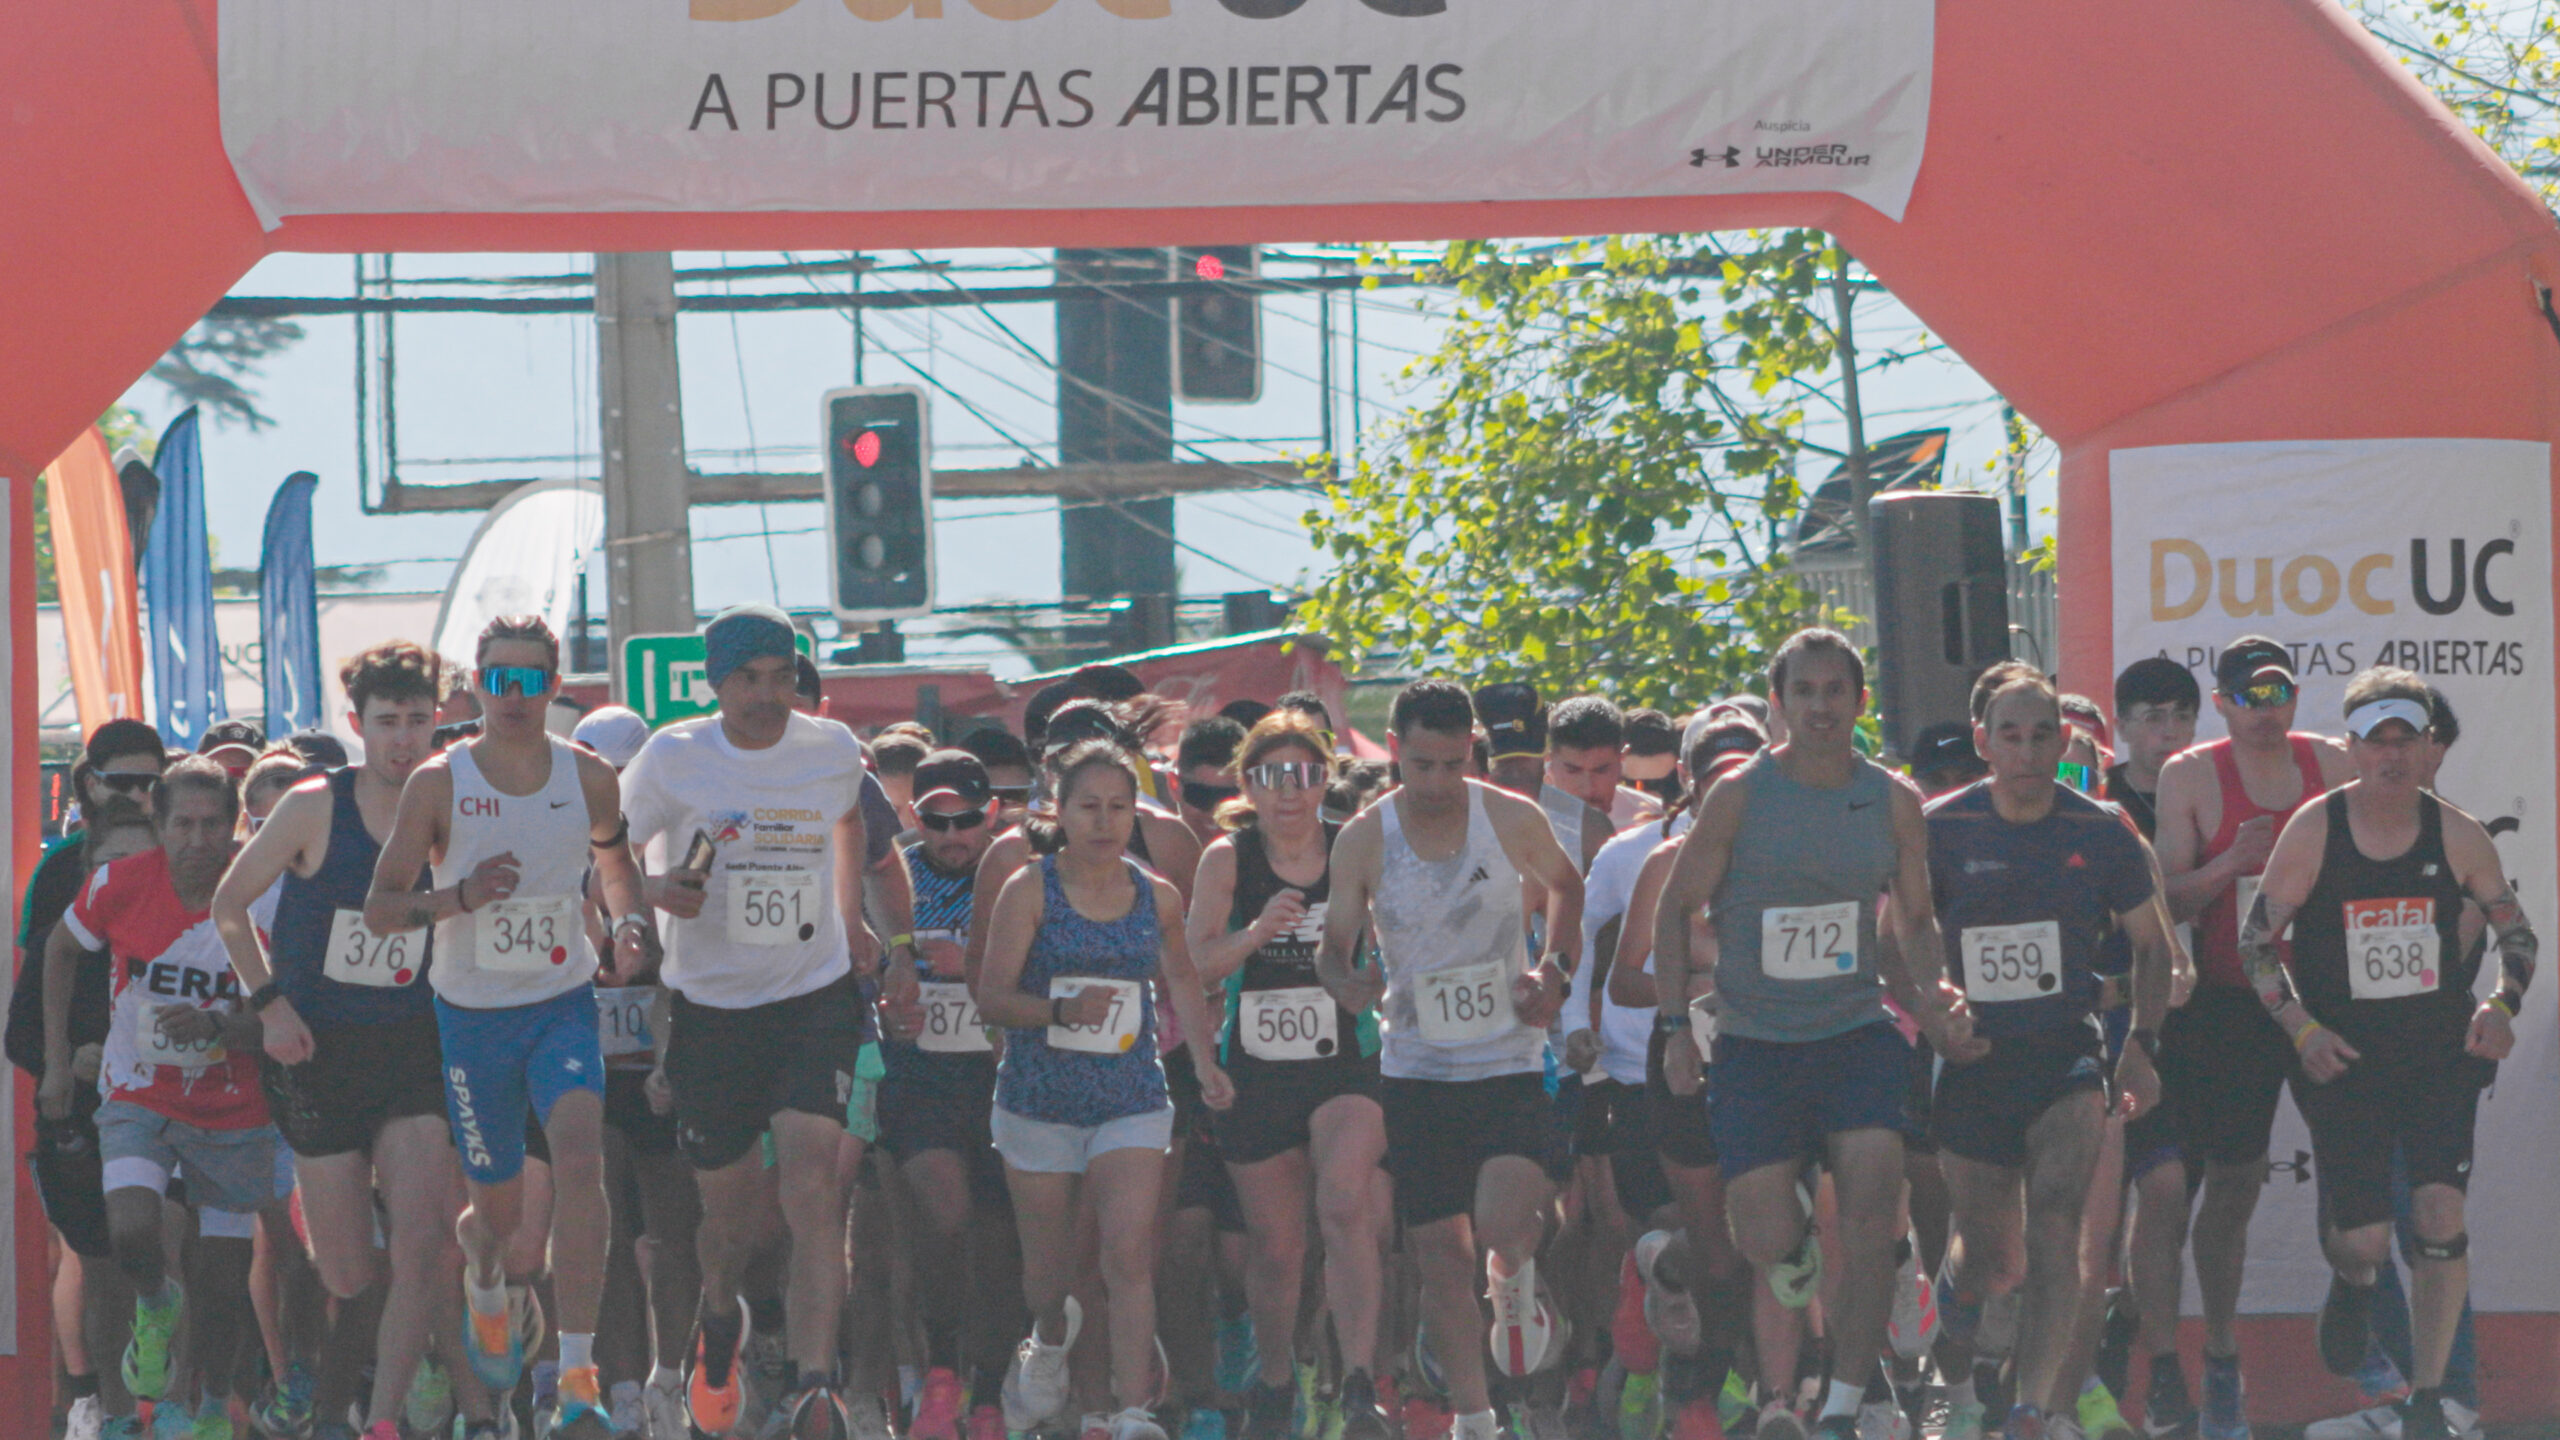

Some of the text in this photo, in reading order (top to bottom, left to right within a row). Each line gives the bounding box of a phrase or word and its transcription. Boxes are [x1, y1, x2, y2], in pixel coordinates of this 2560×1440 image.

[689, 63, 1467, 131] A PUERTAS ABIERTAS
[1754, 120, 1811, 134] Auspicia
[1754, 154, 1870, 168] ARMOUR
[1756, 144, 1848, 160] UNDER
[2187, 640, 2523, 676] PUTAS ABIERTAS
[459, 797, 500, 817] CHI
[754, 808, 823, 821] CORRIDA
[753, 823, 795, 832] Familiar
[754, 833, 825, 845] SOLIDARIA
[745, 889, 800, 927] 561
[2346, 901, 2433, 929] icafal
[345, 930, 407, 970] 376
[493, 916, 555, 953] 343
[1780, 922, 1842, 963] 712
[1981, 942, 2042, 983] 559
[2365, 942, 2424, 981] 638
[930, 1001, 985, 1036] 874
[1434, 982, 1494, 1022] 185
[1258, 1005, 1318, 1042] 560
